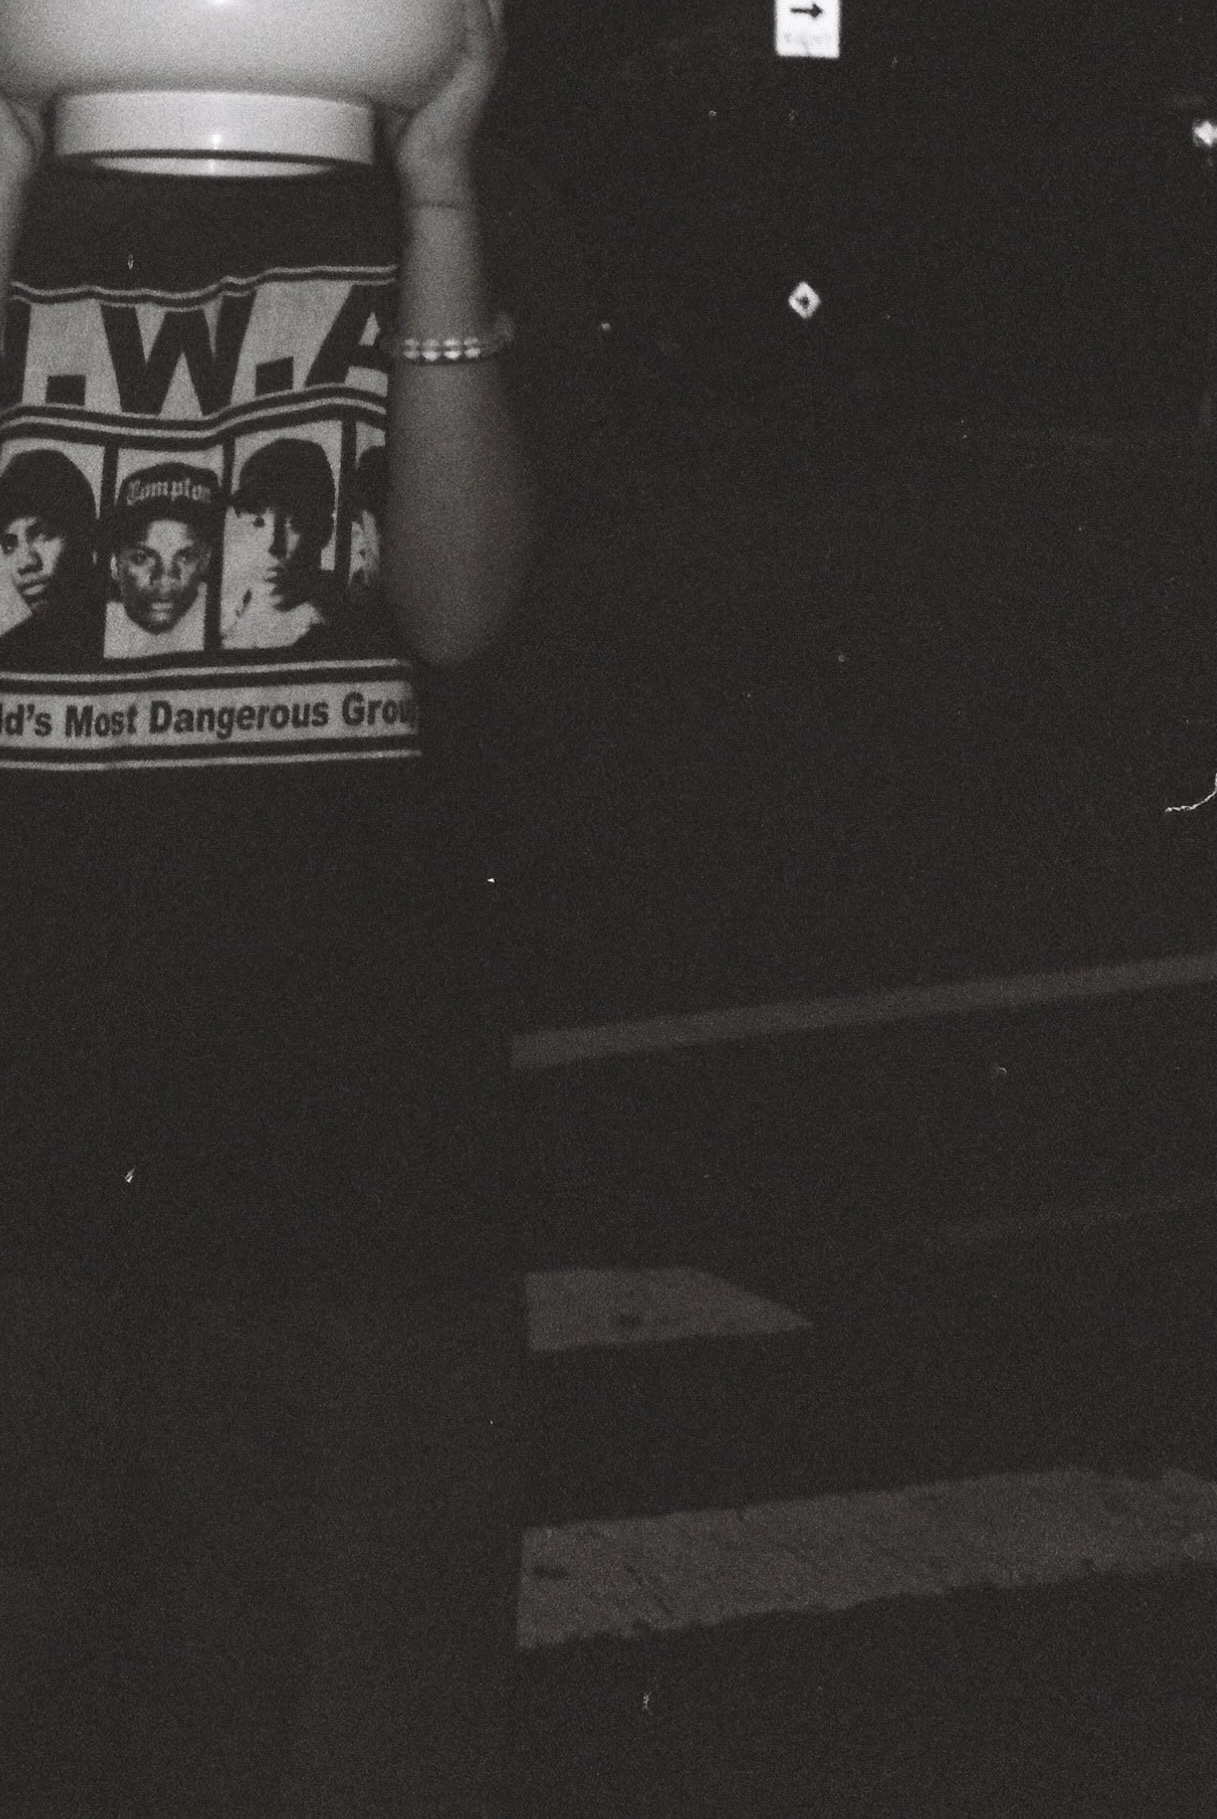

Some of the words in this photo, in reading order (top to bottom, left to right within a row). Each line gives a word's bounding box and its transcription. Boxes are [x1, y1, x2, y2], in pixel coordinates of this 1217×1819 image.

[127, 478, 212, 507] Compton
[66, 704, 138, 738] Most
[149, 699, 329, 740] Dangerous
